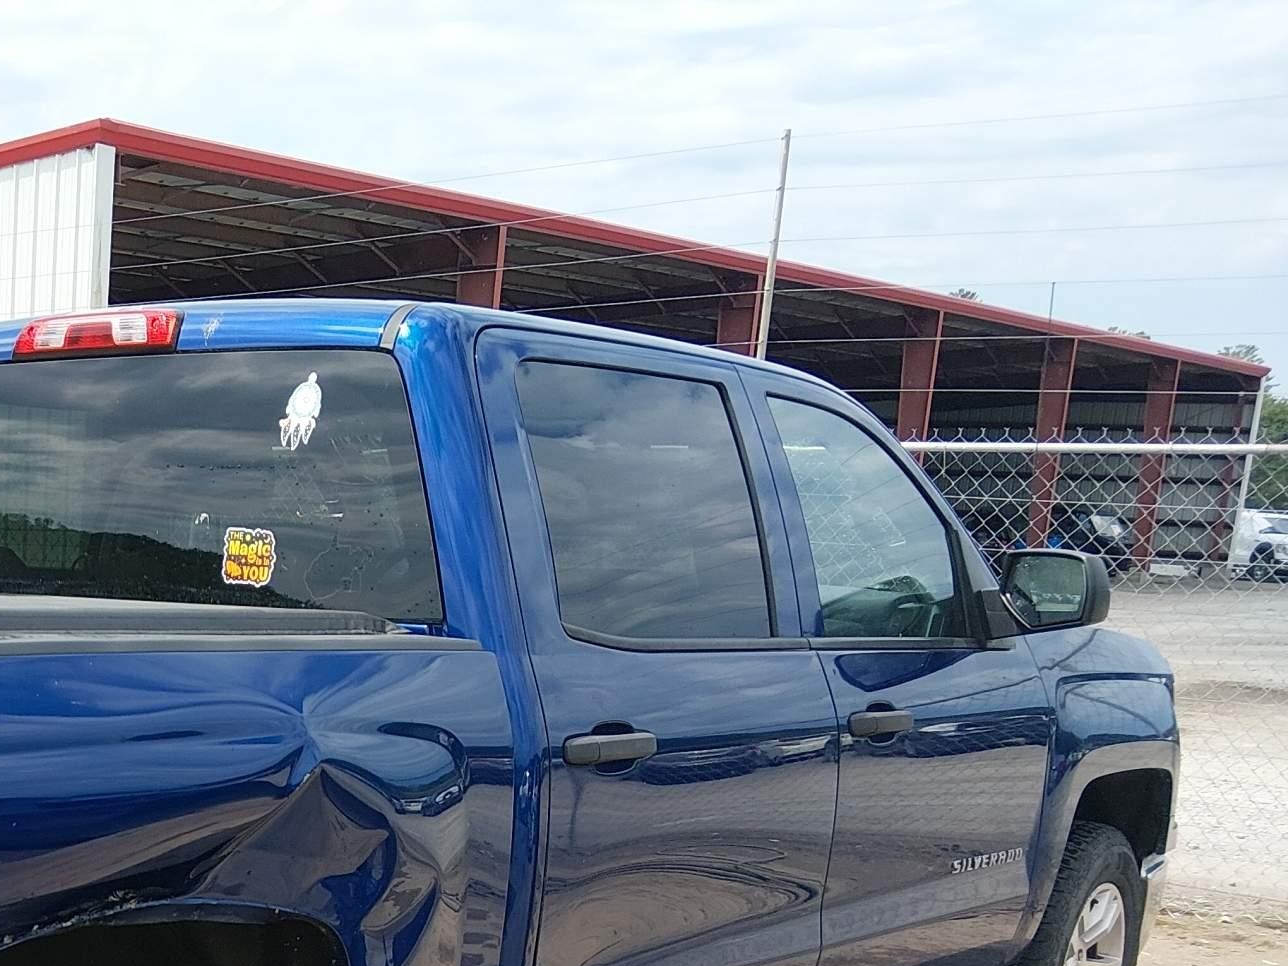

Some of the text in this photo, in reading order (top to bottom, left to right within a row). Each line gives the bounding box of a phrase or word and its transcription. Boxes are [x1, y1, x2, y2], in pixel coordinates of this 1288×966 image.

[230, 531, 244, 541] THE
[228, 540, 271, 564] Magic
[242, 565, 269, 581] YOU
[951, 847, 1024, 874] SILVERADO
